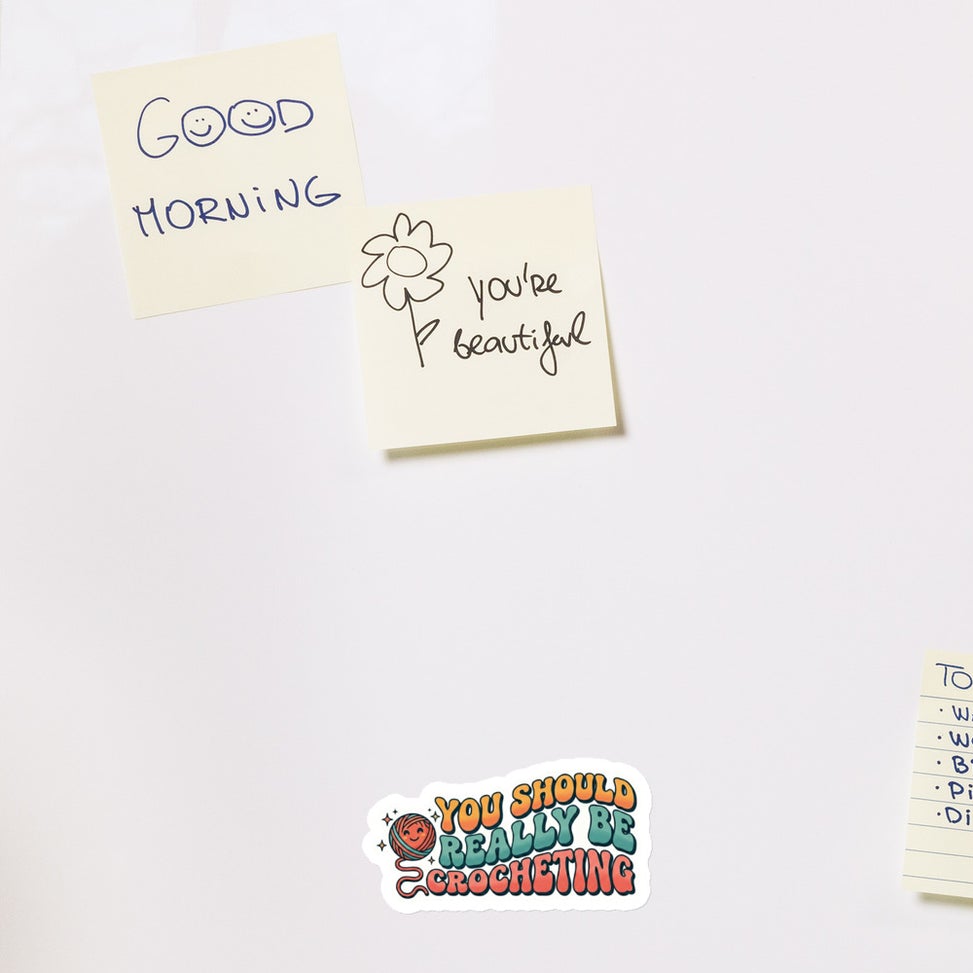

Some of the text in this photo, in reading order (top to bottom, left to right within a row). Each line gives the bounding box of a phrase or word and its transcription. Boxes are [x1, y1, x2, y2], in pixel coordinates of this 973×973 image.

[137, 97, 313, 158] GOOD
[468, 262, 563, 321] you're
[453, 311, 592, 376] beautiful
[936, 663, 973, 690] TO
[434, 773, 637, 834] YOU SHOULD
[439, 804, 637, 869] REALLY BE
[426, 848, 636, 896] CROCHETING
